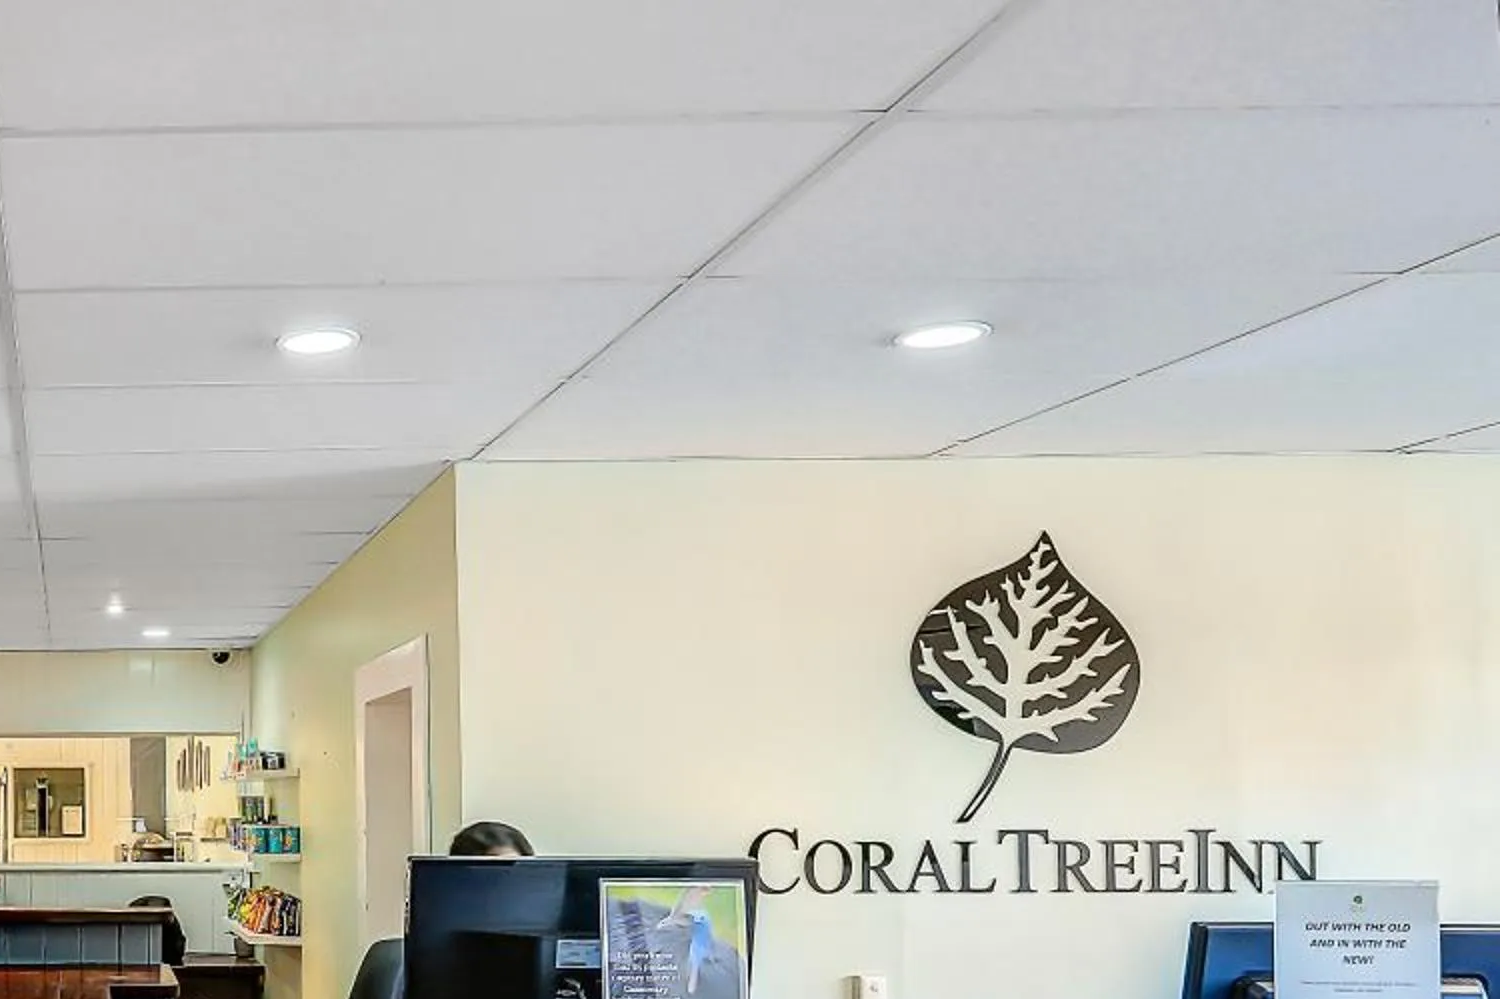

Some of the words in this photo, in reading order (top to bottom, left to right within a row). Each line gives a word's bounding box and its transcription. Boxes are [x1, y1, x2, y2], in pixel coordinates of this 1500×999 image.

[1305, 922, 1329, 932] OUT
[1331, 922, 1361, 932] WITH
[1364, 922, 1386, 933] THE
[1387, 922, 1412, 933] OLD
[1309, 938, 1335, 948] AND
[1337, 938, 1350, 948] IN
[1352, 938, 1383, 949] WITH
[1385, 938, 1407, 949] THE
